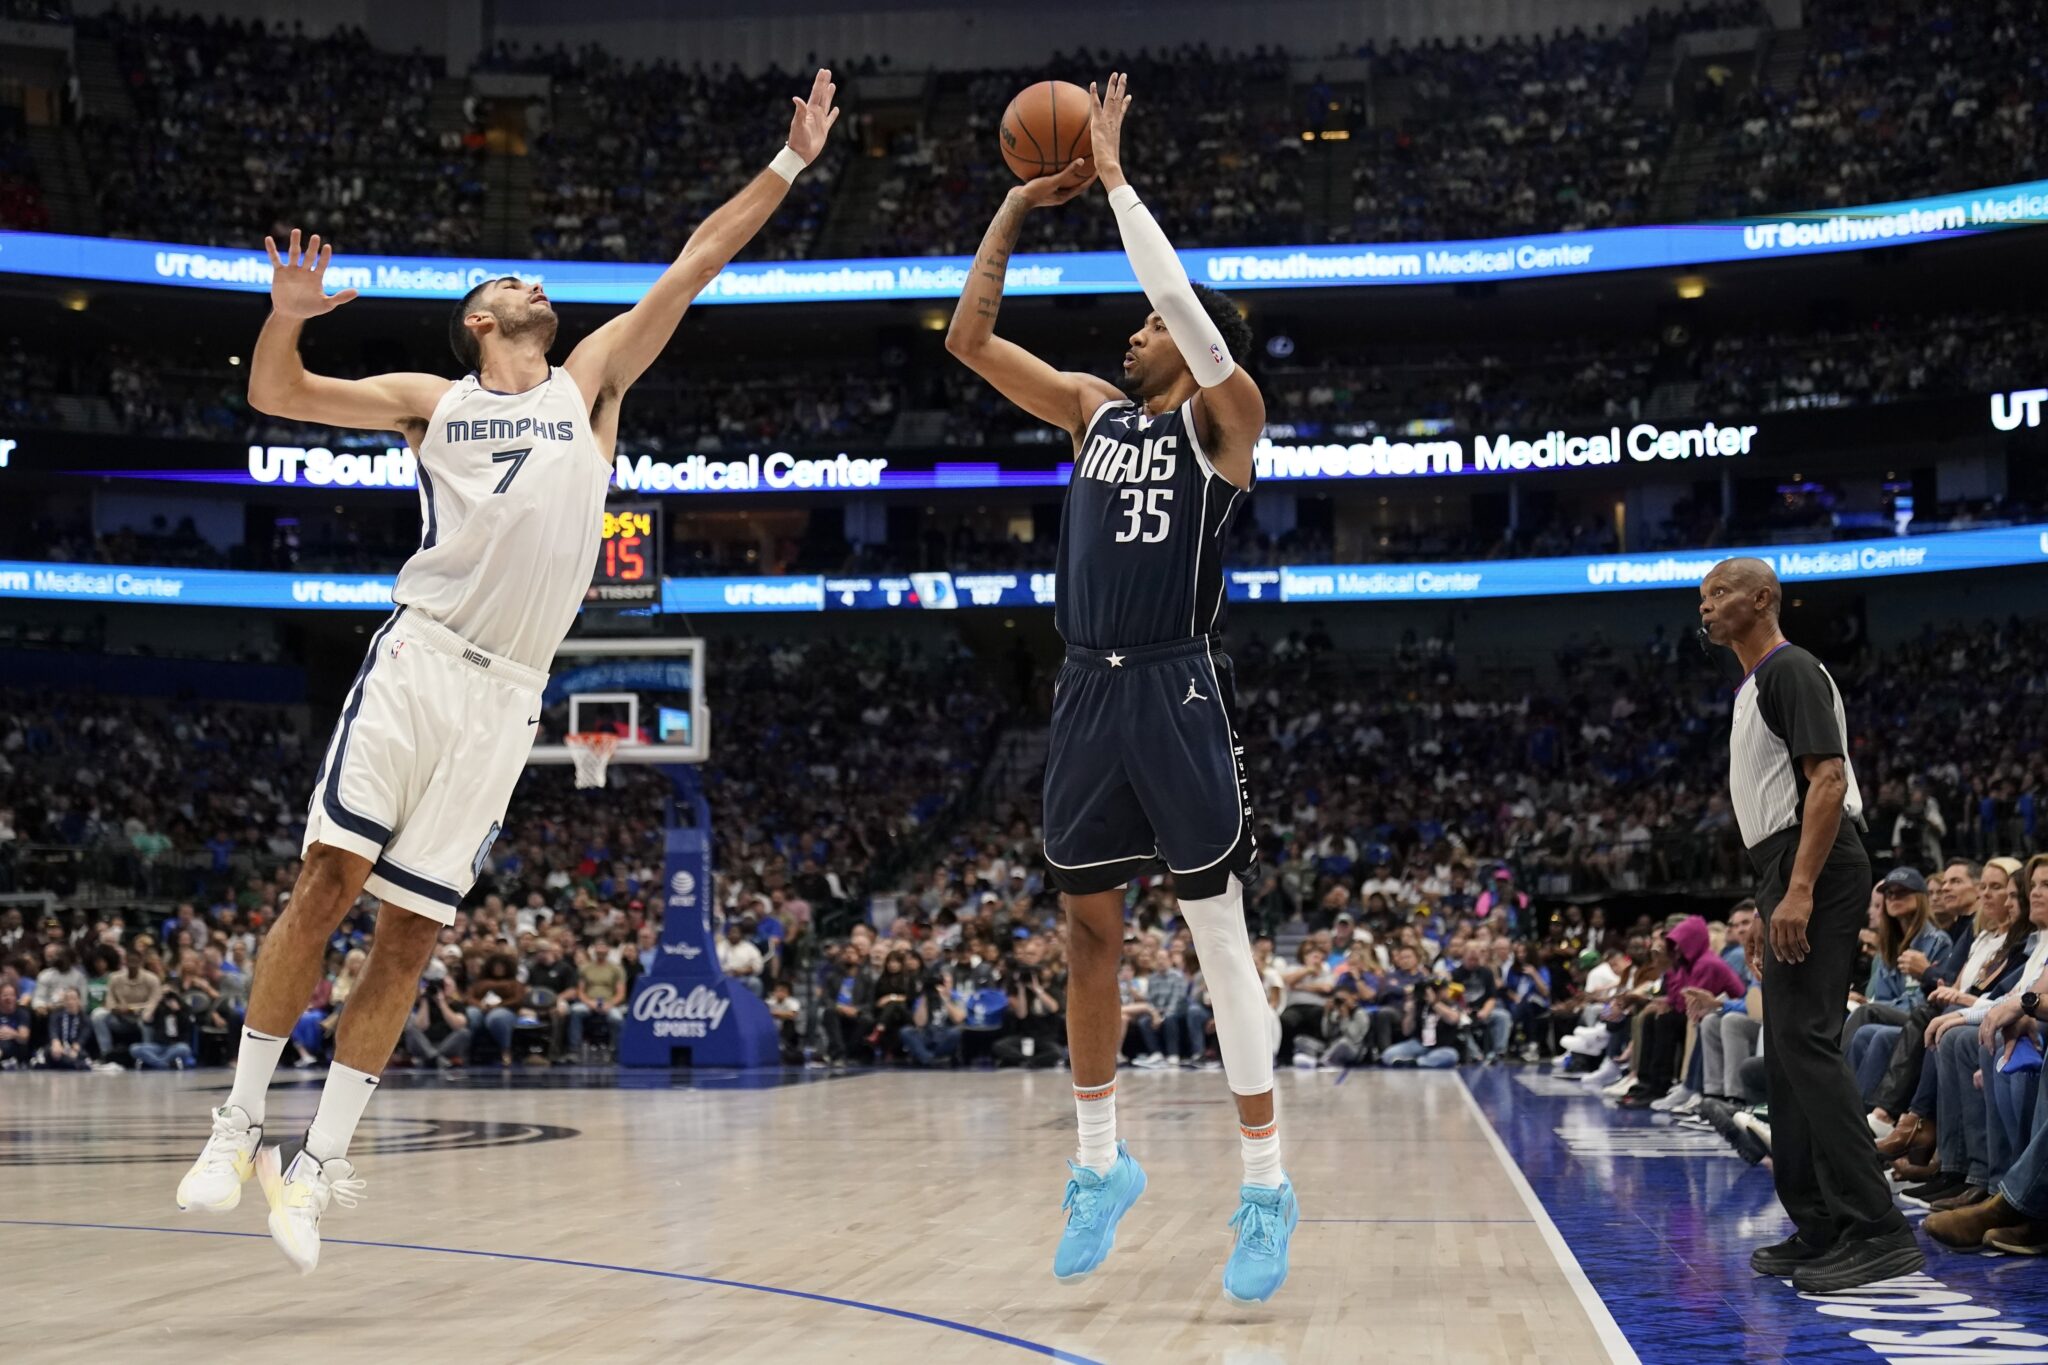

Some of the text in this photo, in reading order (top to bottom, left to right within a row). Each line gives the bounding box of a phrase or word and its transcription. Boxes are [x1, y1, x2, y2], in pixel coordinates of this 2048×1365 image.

[1744, 206, 1965, 250] UTSouthwestern
[376, 265, 466, 290] Medical
[1004, 264, 1063, 286] enter
[1207, 244, 1594, 282] UTSouthwestern Medical Center
[446, 417, 573, 443] MEMPHIS
[1475, 427, 1620, 470] Medical
[1626, 423, 1757, 458] Center
[492, 447, 532, 494] 7
[616, 453, 759, 490] Medical
[763, 452, 888, 488] Center
[1080, 434, 1177, 484] MAVS
[1115, 488, 1174, 543] 35
[606, 537, 643, 579] 15
[1779, 549, 1858, 576] Medical
[1860, 546, 1928, 571] Center
[34, 570, 114, 595] Medical
[115, 573, 183, 597] Center
[1338, 572, 1415, 594] Medical
[1416, 571, 1482, 592] Center
[633, 983, 730, 1031] Bally
[653, 1020, 707, 1038] SPORTS
